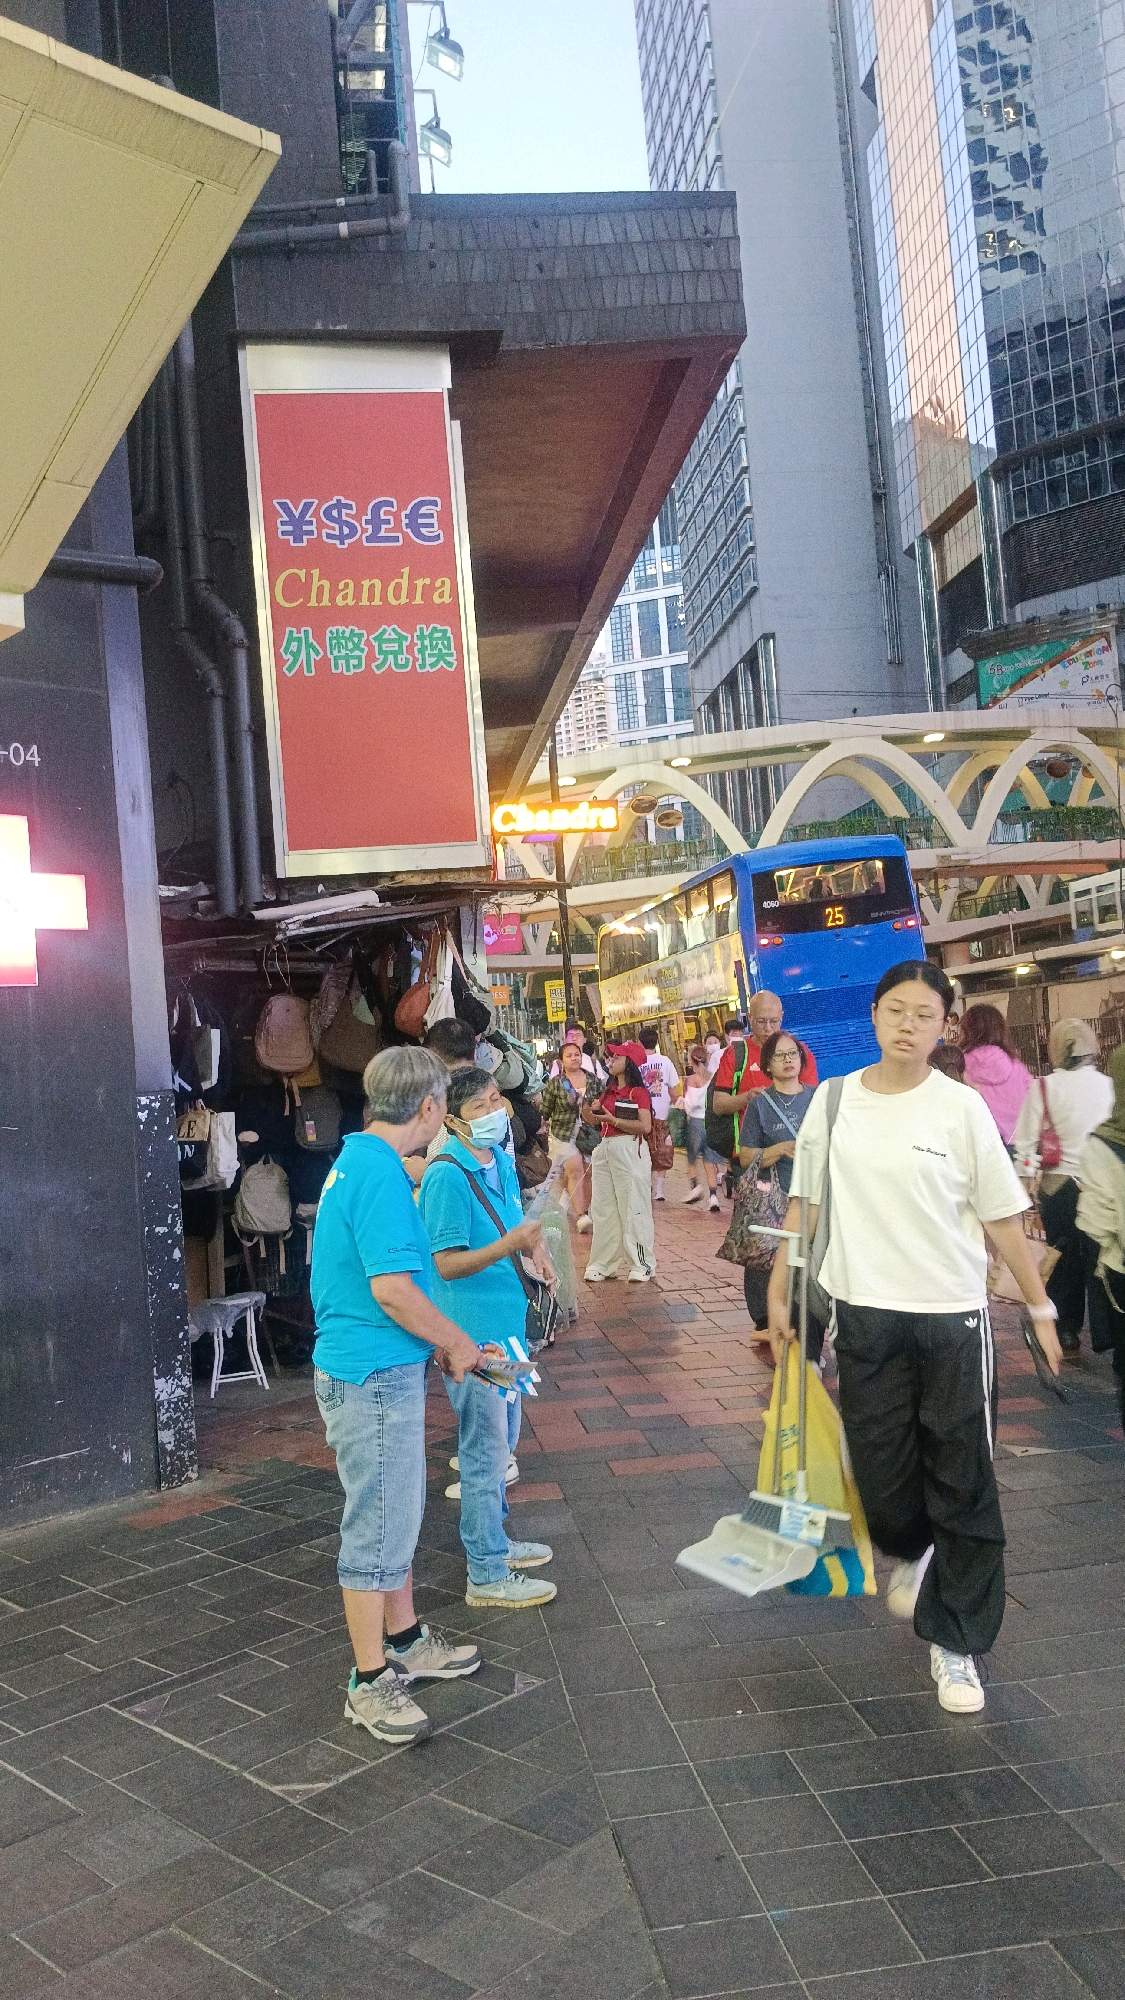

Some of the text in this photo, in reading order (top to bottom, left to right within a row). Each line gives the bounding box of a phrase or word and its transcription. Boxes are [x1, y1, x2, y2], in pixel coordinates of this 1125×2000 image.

[274, 566, 452, 608] Chandra
[280, 624, 457, 676] 外幣兌換
[491, 801, 618, 833] Chandra
[824, 905, 845, 927] 25
